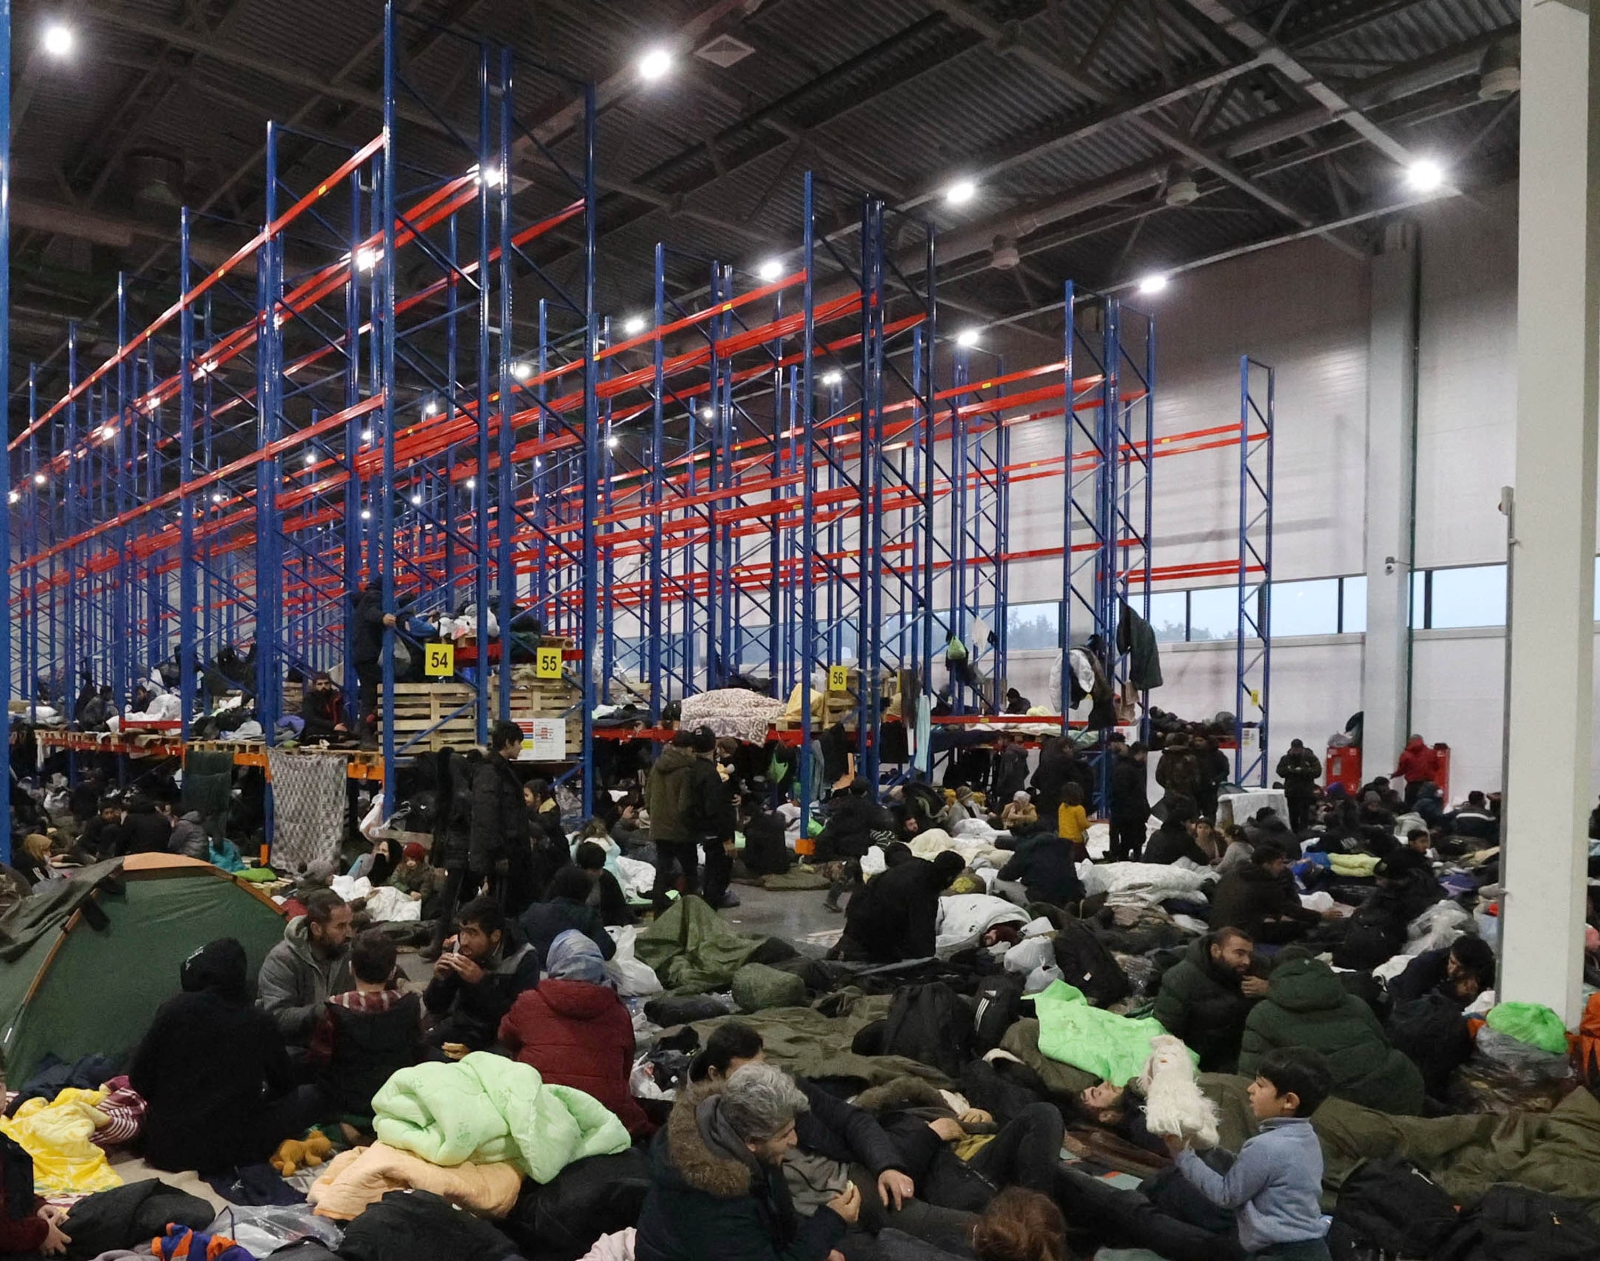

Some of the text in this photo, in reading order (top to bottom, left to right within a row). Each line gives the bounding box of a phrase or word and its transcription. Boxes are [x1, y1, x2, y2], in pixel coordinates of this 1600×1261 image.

[431, 652, 448, 668] 54
[542, 656, 557, 671] 55
[833, 672, 844, 684] 56
